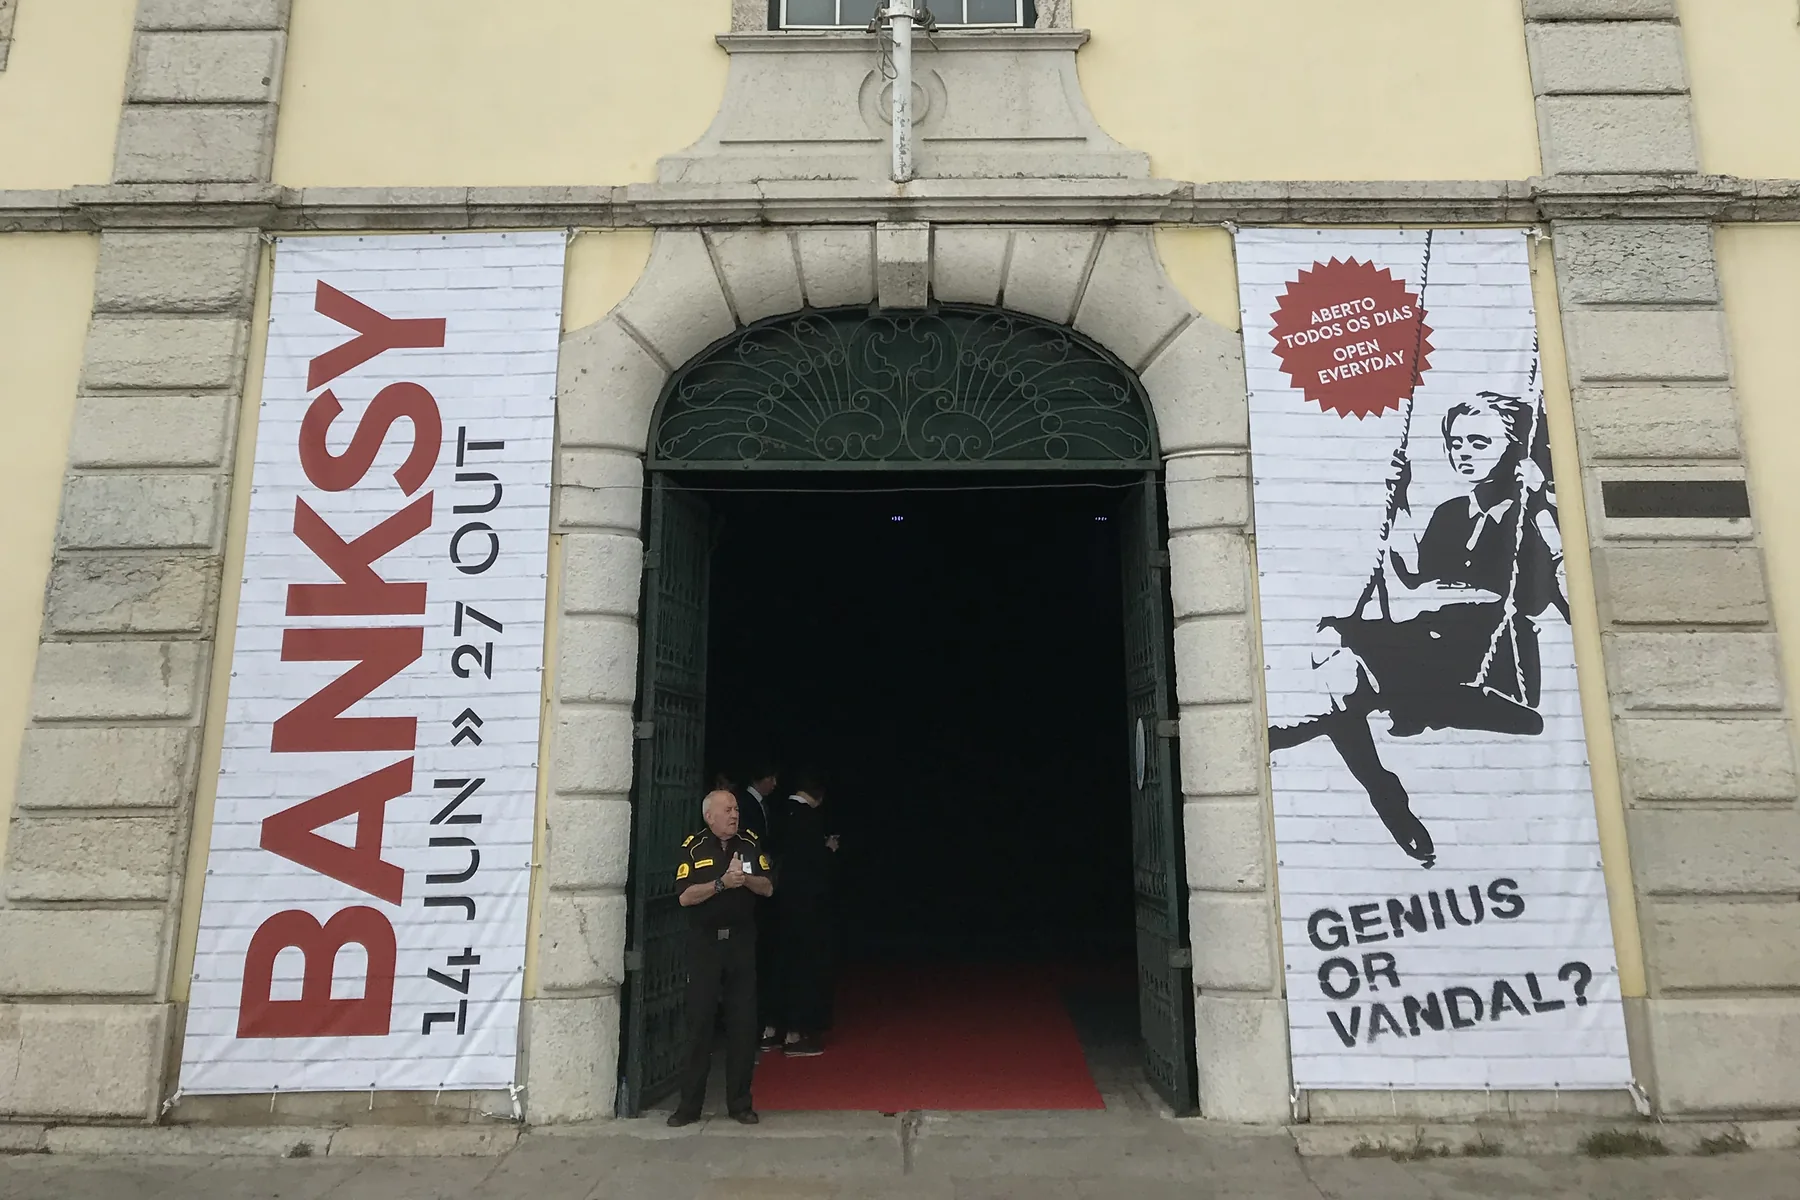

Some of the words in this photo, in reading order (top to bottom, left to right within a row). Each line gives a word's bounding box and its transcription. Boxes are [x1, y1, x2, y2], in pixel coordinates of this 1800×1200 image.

[1282, 322, 1343, 349] TODOS
[1346, 315, 1371, 332] OS
[1373, 305, 1413, 327] DIAS
[1311, 297, 1376, 325] ABERTO
[1318, 350, 1404, 385] EVERYDAY
[1333, 338, 1381, 362] OPEN
[450, 426, 505, 575] OUT
[236, 279, 446, 1040] BANKSY
[451, 600, 503, 680] 27
[424, 778, 486, 921] JUN
[1307, 877, 1526, 951] GENIUS
[422, 947, 480, 1036] 14
[1317, 951, 1401, 1000] OR
[1327, 961, 1593, 1048] VANDAL?
